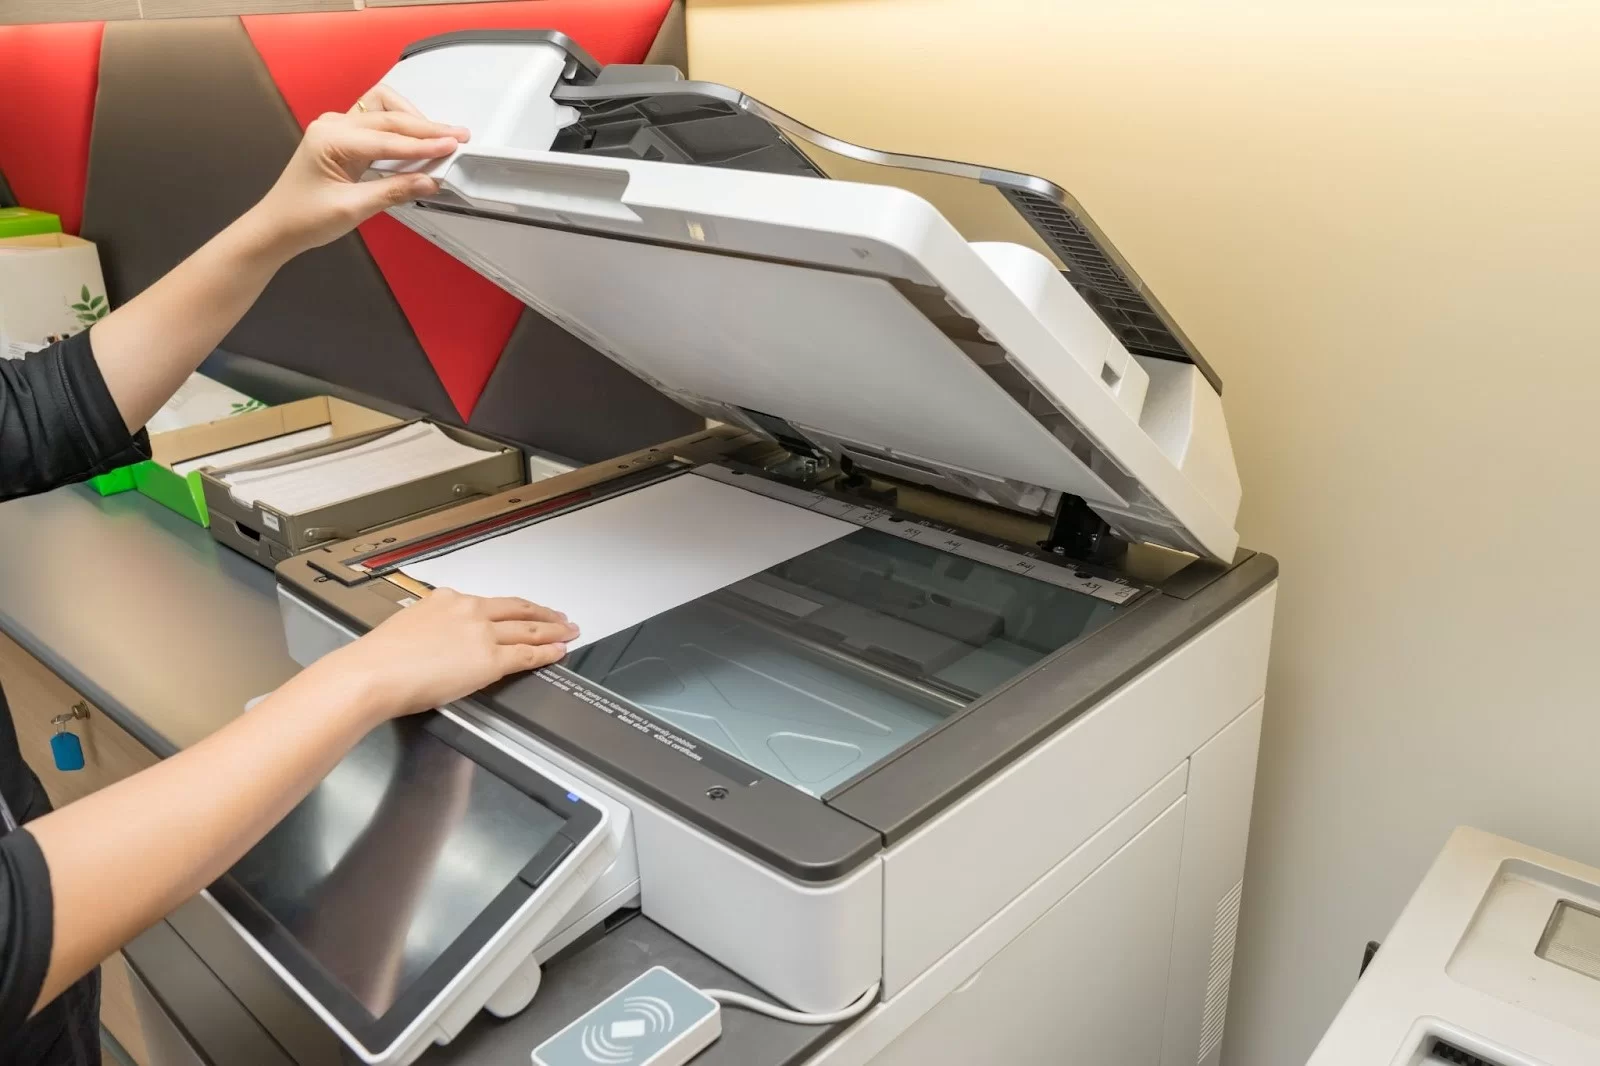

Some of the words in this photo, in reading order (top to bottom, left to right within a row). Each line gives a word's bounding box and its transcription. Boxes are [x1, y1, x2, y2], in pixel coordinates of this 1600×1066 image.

[609, 702, 631, 715] following
[629, 712, 644, 722] items
[645, 723, 671, 737] generally
[671, 743, 703, 761] certificates
